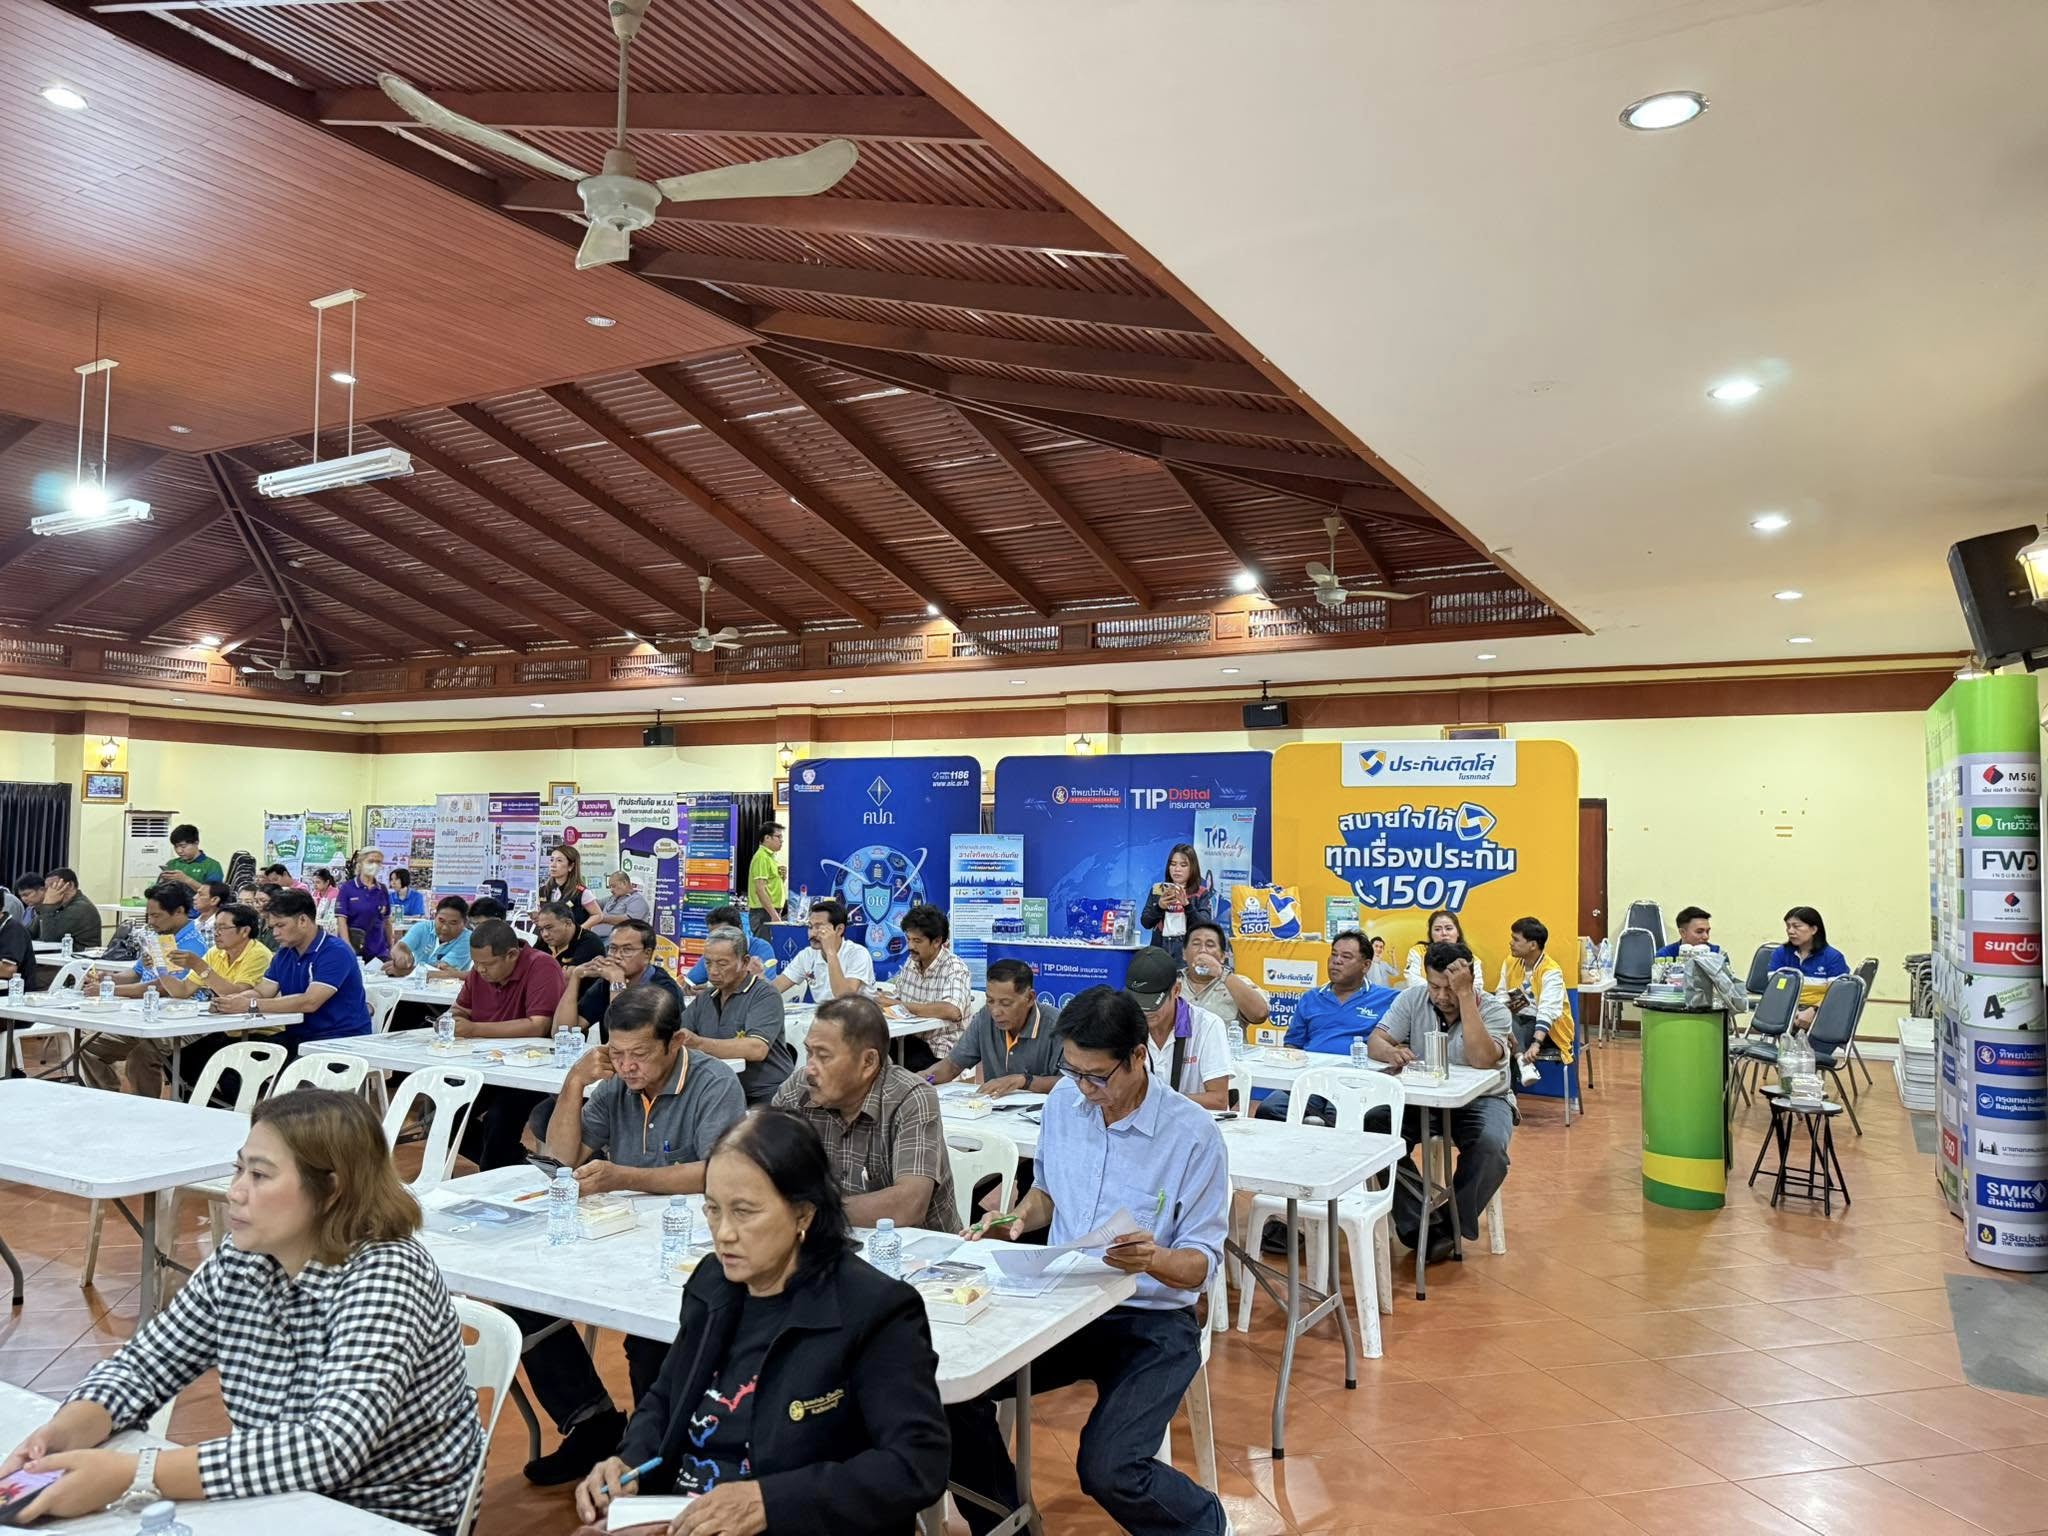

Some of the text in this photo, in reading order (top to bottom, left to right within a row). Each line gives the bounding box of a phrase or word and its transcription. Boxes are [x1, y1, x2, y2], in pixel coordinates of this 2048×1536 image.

[1389, 752, 1496, 774] ประกันติดโล่
[951, 770, 970, 780] 1186
[2009, 772, 2036, 781] MSIG
[1071, 787, 1120, 797] ทิพยประกันภัย
[1130, 788, 1168, 810] TIP
[1169, 801, 1211, 809] insurance
[863, 808, 895, 825] คปภ.
[1338, 806, 1456, 833] สบายใจได้
[1325, 833, 1516, 875] ทุกเรื่องประกัน
[1982, 850, 2038, 871] FWD
[1372, 875, 1468, 909] 1501
[867, 895, 888, 907] OIC
[1105, 910, 1115, 933] TIP
[1243, 923, 1270, 935] 1501
[1043, 963, 1056, 971] TIP
[1080, 966, 1109, 974] insurance
[1995, 1103, 2027, 1112] Bangkok
[1986, 1182, 2032, 1199] SMK
